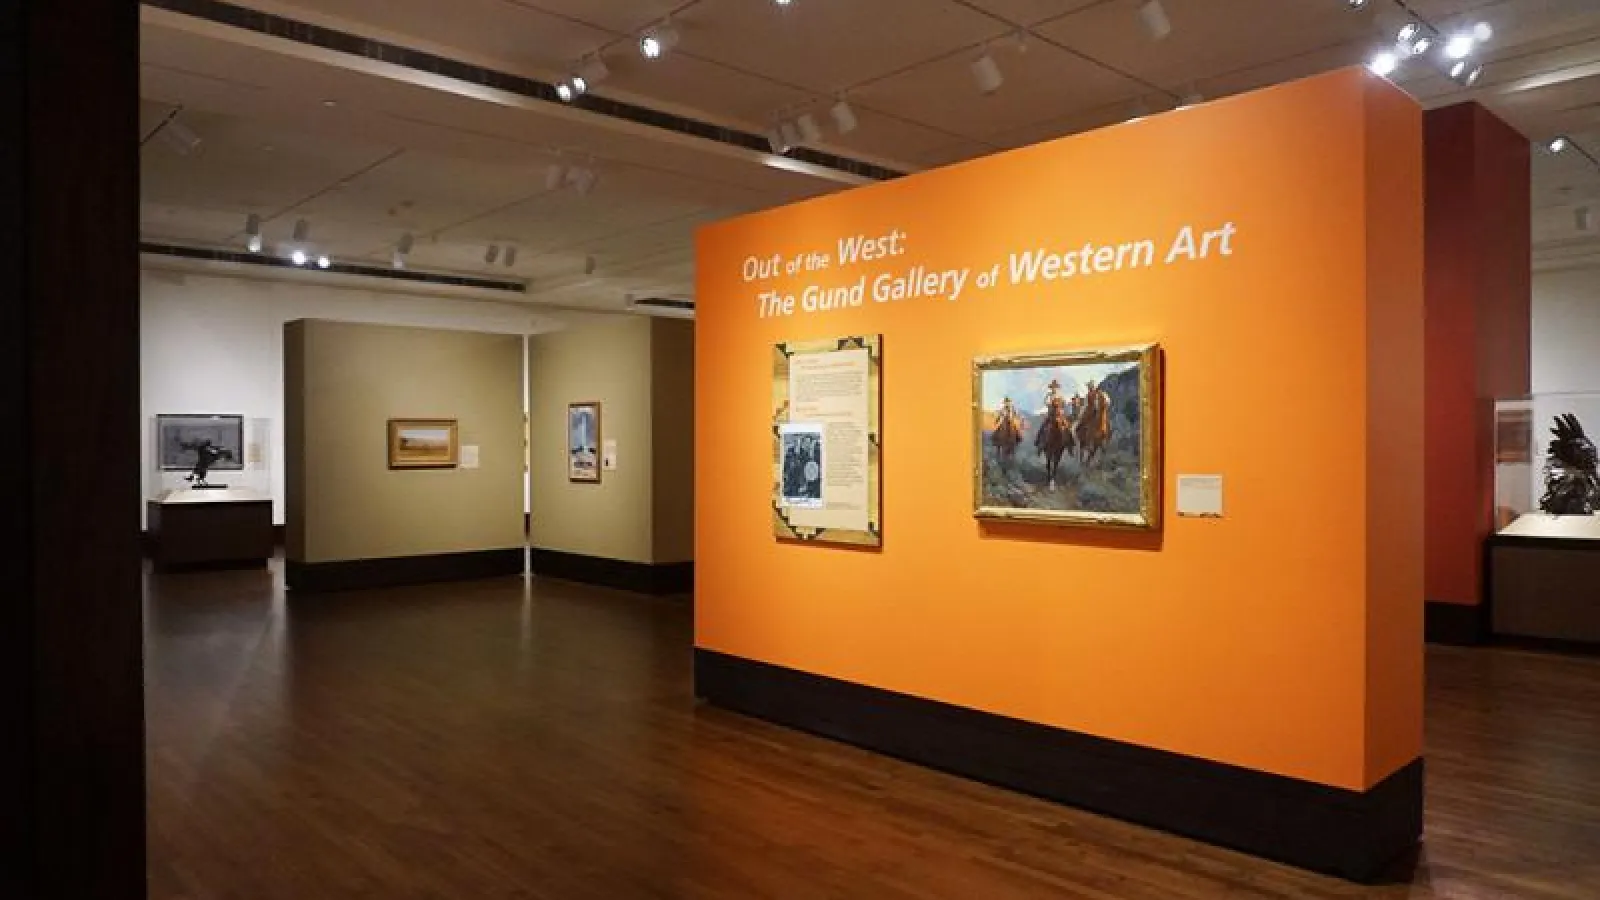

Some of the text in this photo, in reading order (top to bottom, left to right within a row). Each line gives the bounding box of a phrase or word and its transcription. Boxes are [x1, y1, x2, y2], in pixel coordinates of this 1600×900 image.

[743, 229, 907, 283] Out of the West:
[758, 221, 1237, 318] The Gund Gallery of Western Art
